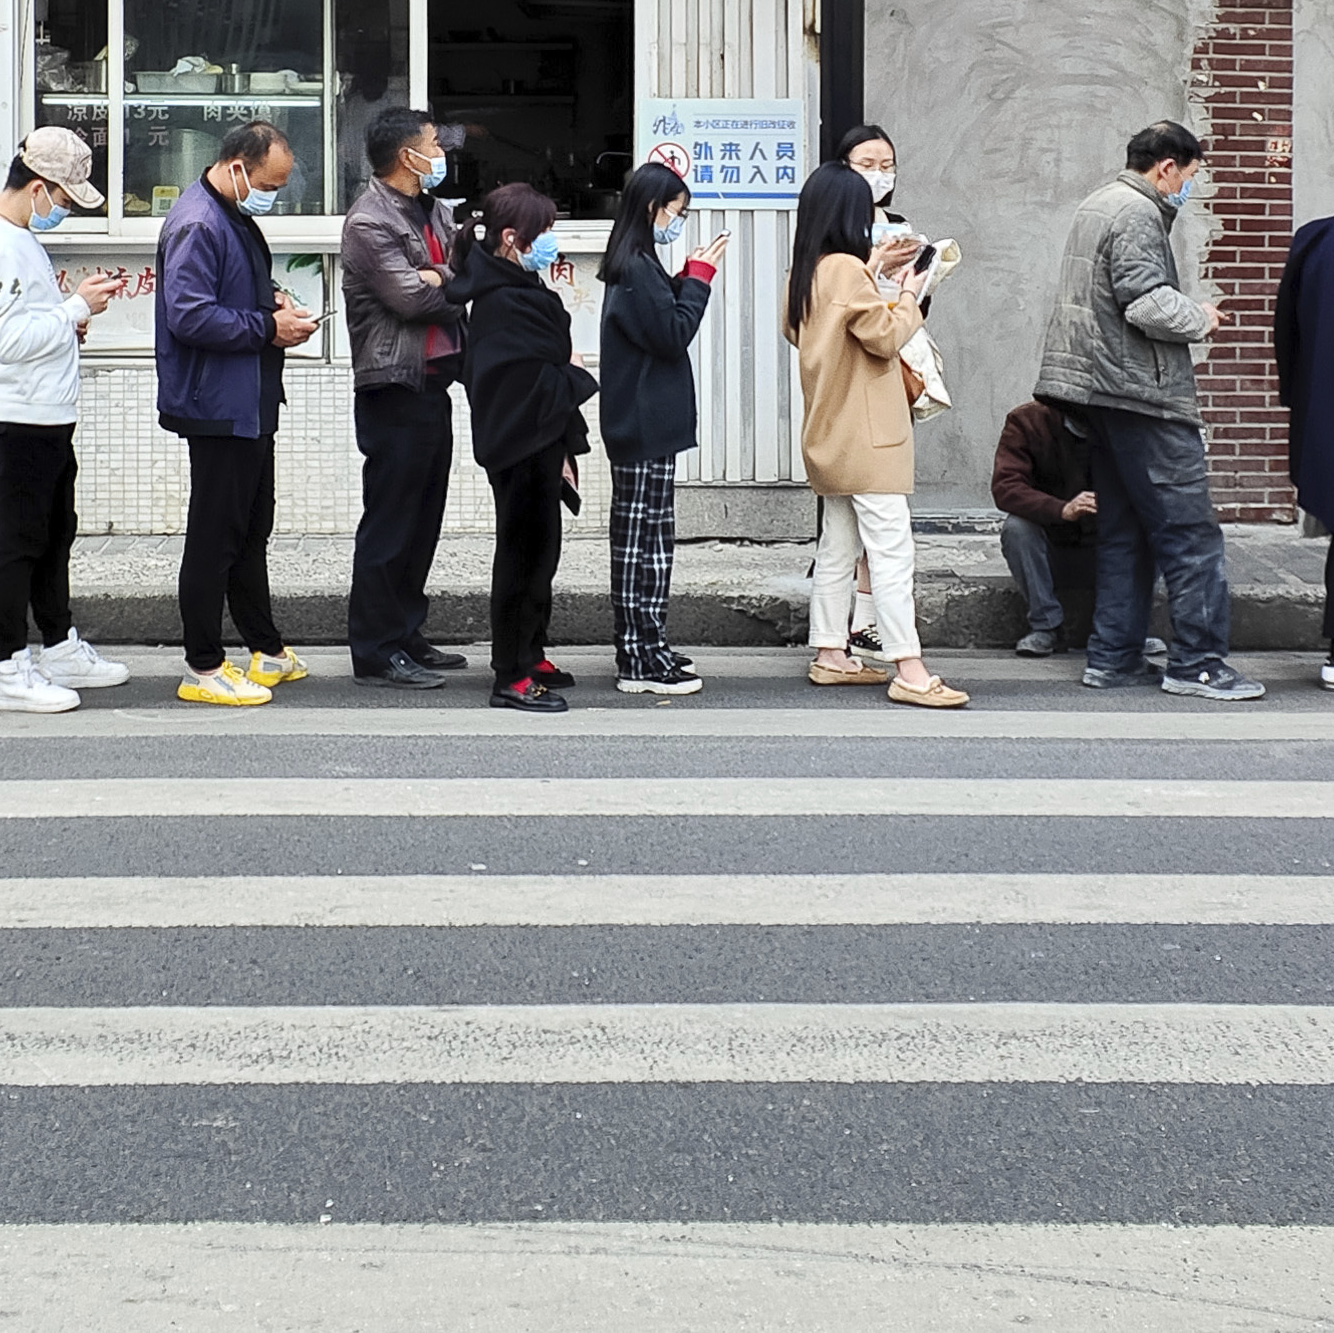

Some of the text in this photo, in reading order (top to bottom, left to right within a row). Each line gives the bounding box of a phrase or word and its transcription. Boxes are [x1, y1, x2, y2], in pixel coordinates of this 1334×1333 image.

[692, 141, 797, 162] 外来人员
[692, 164, 797, 185] 请勿入内
